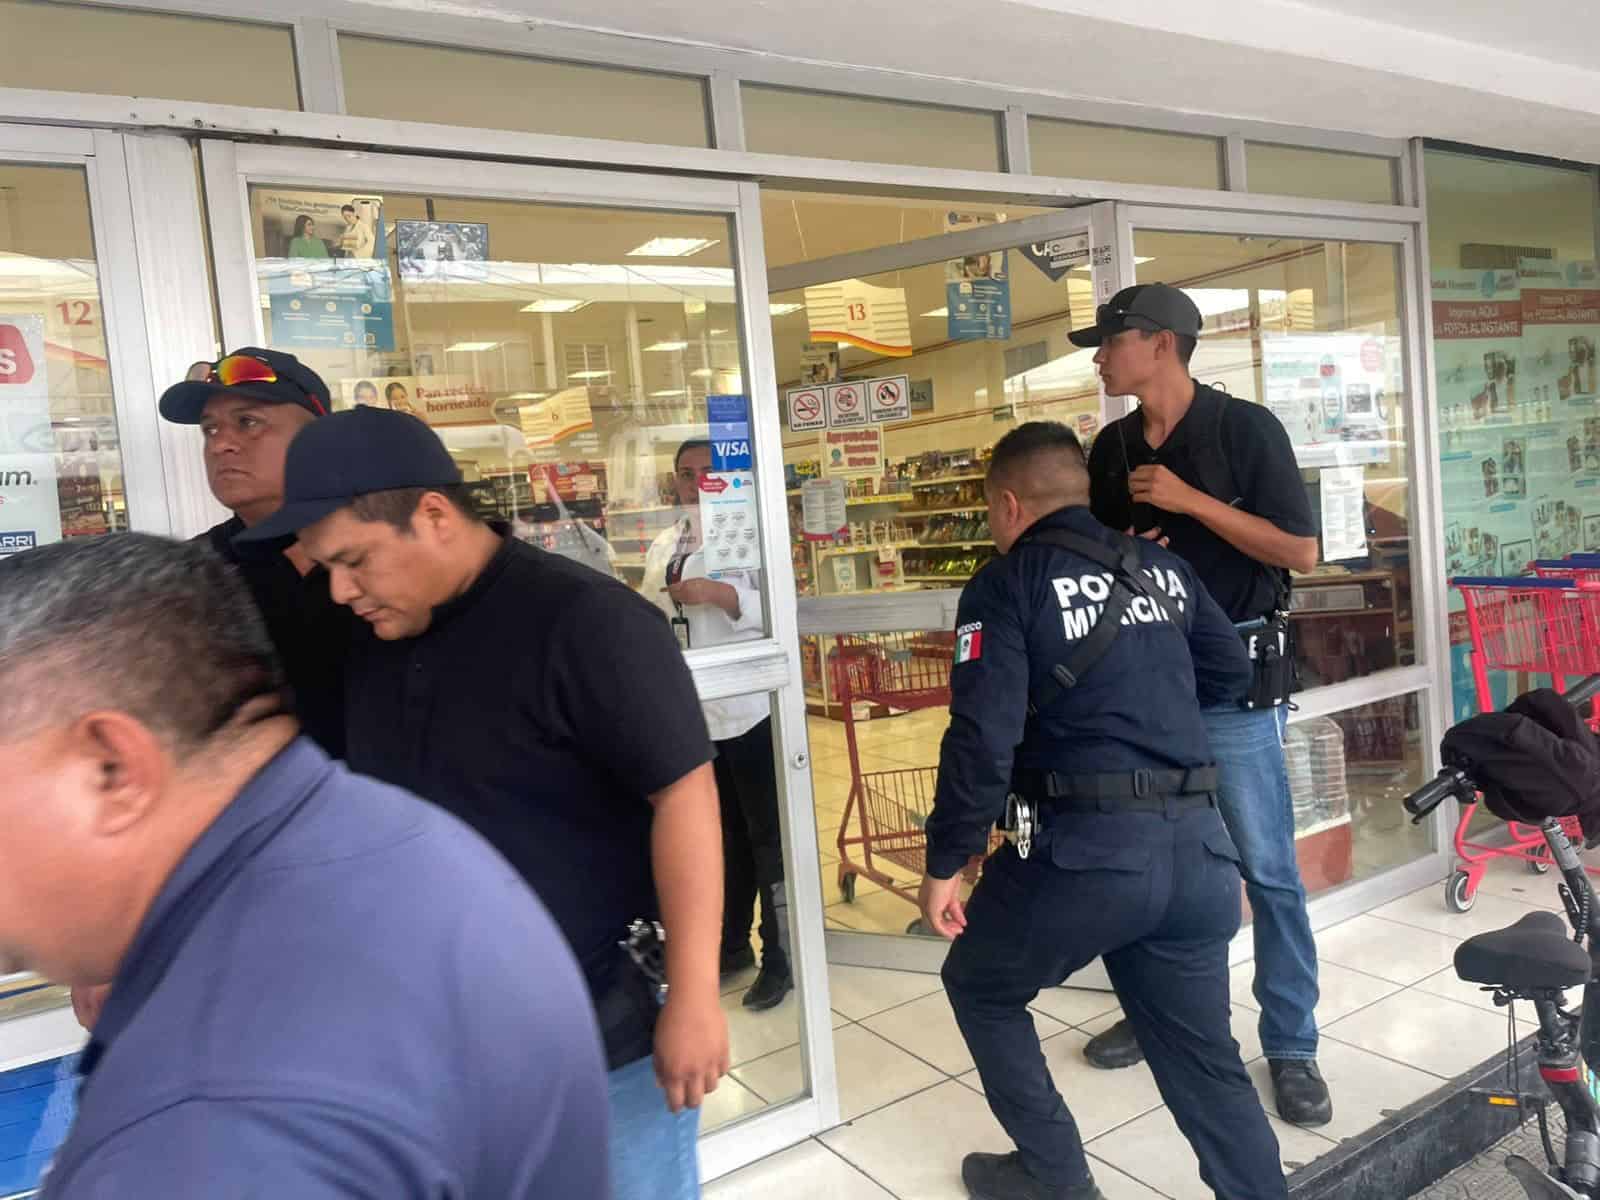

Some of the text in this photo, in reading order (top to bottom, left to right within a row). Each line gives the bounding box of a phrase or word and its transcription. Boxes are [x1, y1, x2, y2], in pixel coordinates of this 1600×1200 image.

[56, 301, 93, 326] 12
[848, 303, 867, 321] 13
[426, 397, 490, 413] horneado
[713, 441, 750, 457] VISA
